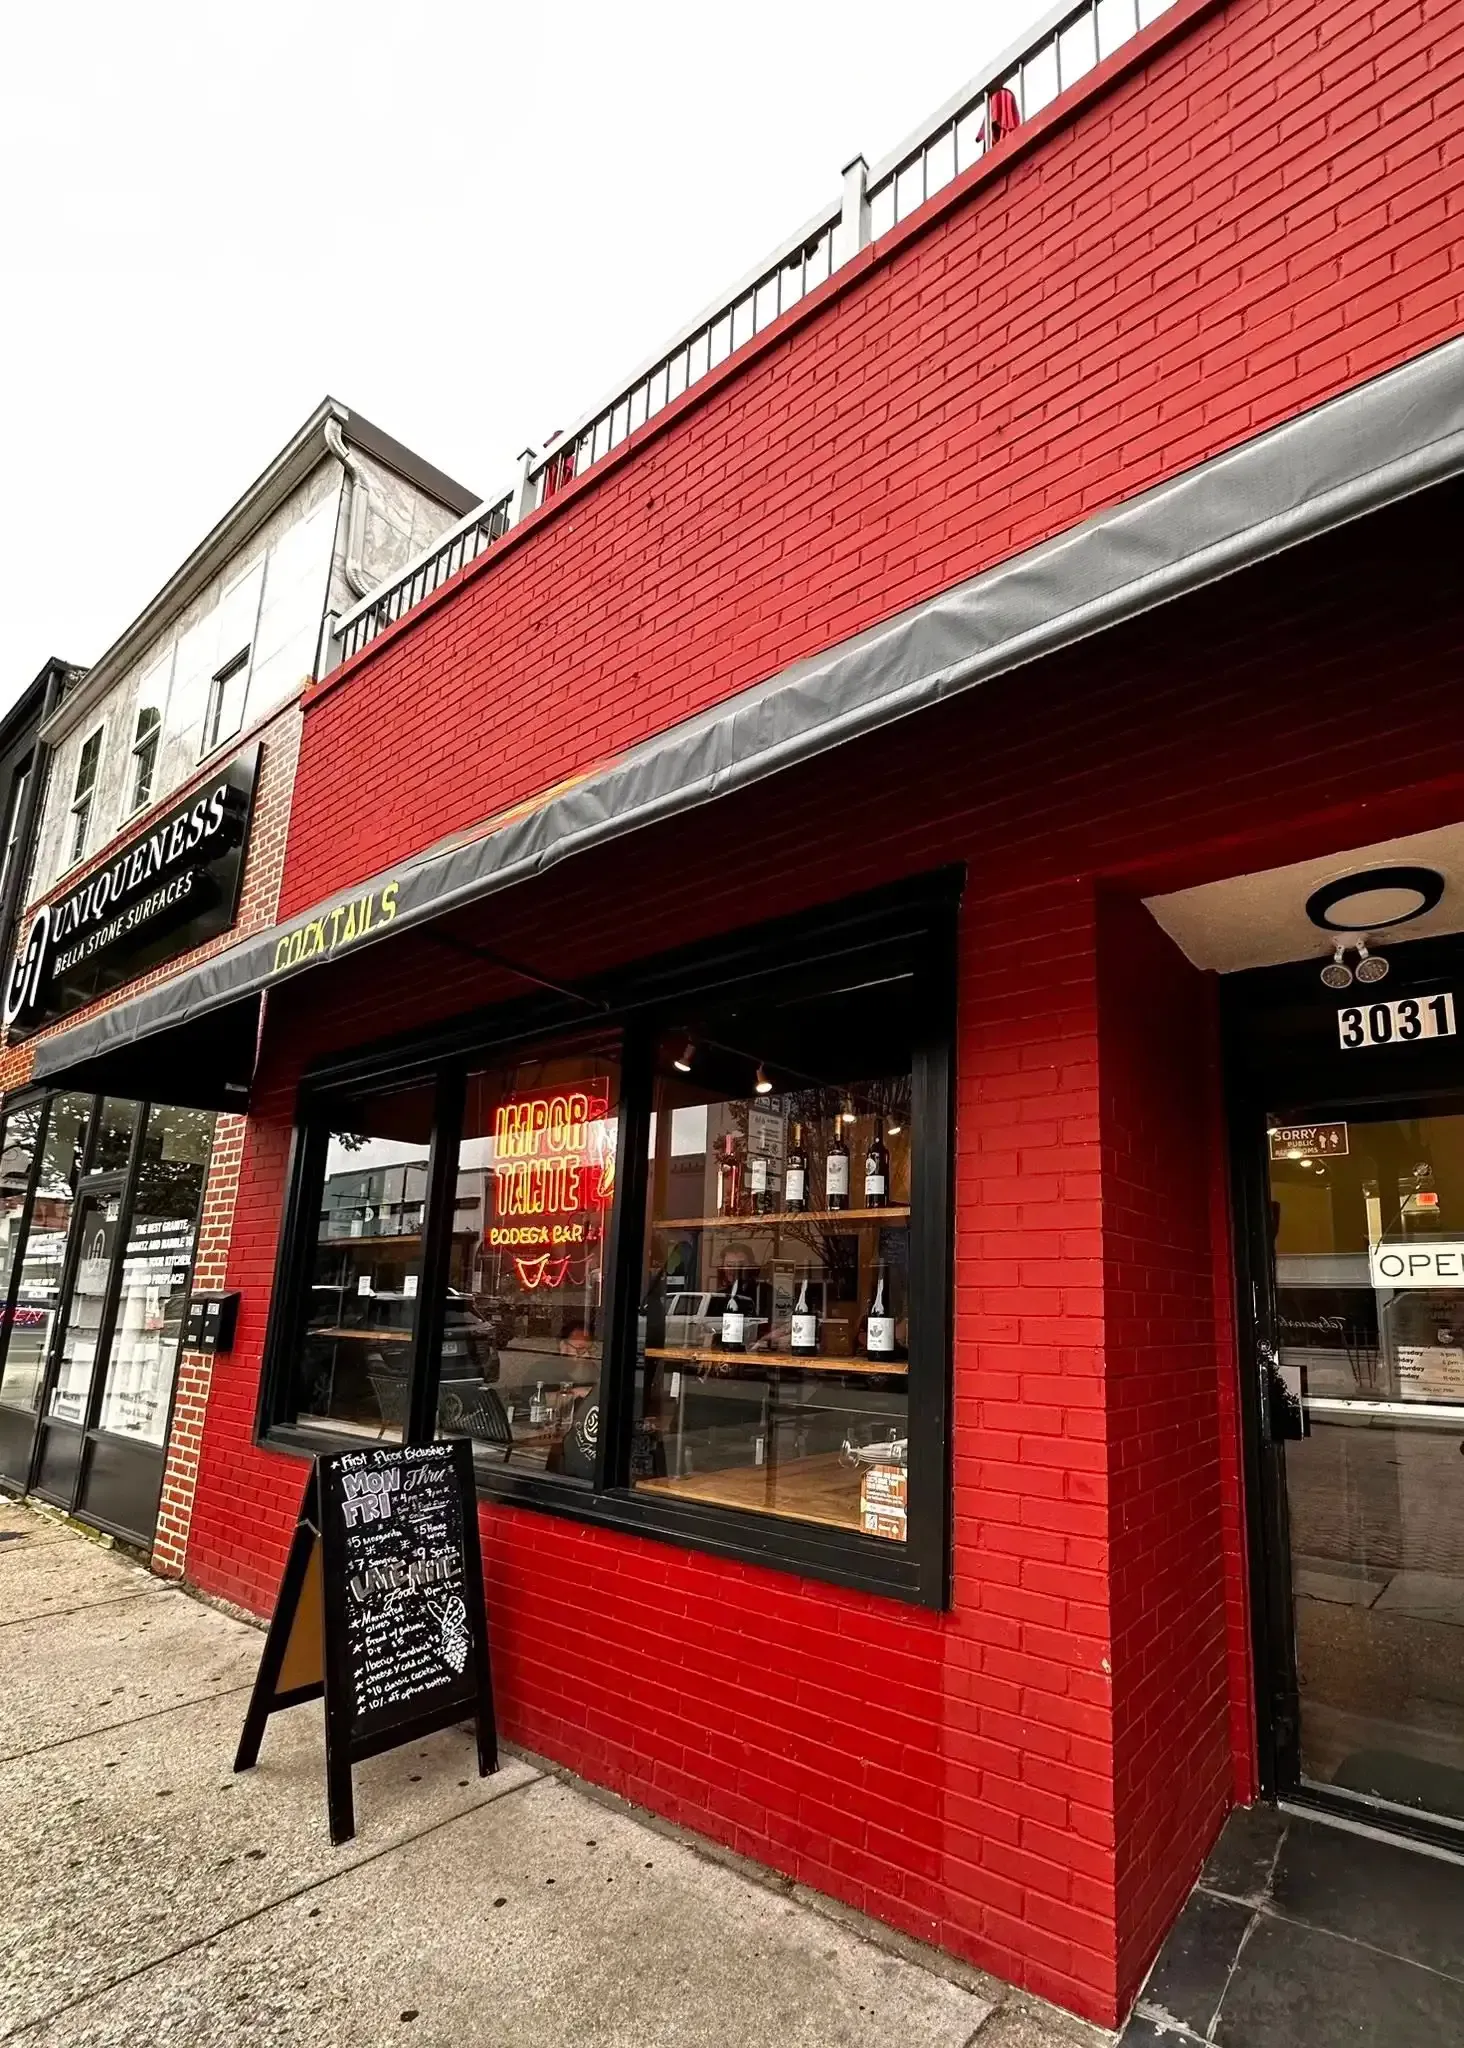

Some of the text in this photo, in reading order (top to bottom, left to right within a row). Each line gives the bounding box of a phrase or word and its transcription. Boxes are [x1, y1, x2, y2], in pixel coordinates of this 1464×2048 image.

[52, 784, 228, 943] UNIQUENESS
[54, 871, 193, 976] BELLA STONE SURFACES
[272, 881, 399, 975] COCKTAILS
[1342, 995, 1449, 1048] 3031
[495, 1093, 588, 1158] IMPOR
[1274, 1128, 1317, 1142] SORRY
[1287, 1139, 1314, 1148] PUBLIC
[497, 1155, 580, 1216] TANTE
[490, 1224, 583, 1245] BODEGA BAR
[1380, 1253, 1464, 1277] OPE
[341, 1445, 445, 1470] First Floor Exclusive
[342, 1464, 446, 1500] MON Thru
[342, 1492, 391, 1528] FRI
[348, 1558, 365, 1571] $7
[412, 1547, 426, 1560] $9
[350, 1560, 409, 1602] LATE
[396, 1641, 432, 1660] Sandwich
[366, 1668, 393, 1685] cheese
[401, 1659, 416, 1671] cold
[384, 1676, 409, 1692] classic
[388, 1690, 399, 1702] off
